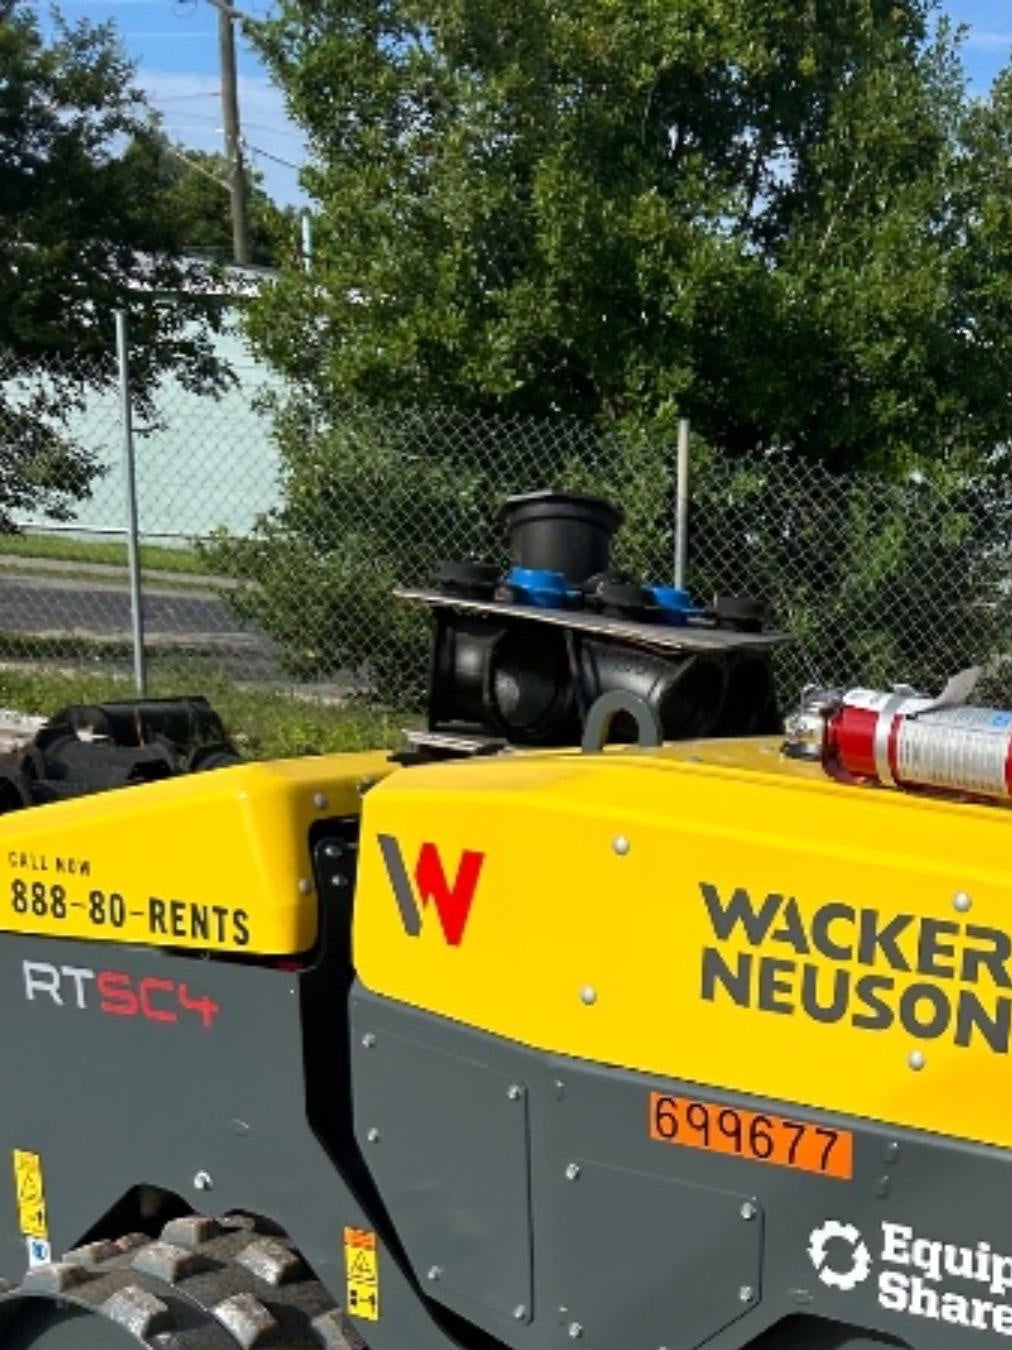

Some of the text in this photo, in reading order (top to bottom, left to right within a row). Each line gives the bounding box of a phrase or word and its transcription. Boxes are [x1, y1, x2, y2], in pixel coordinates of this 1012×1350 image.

[8, 851, 91, 876] CALL NOW
[11, 878, 249, 946] 888-80-RENTS
[22, 960, 220, 1028] RTSC4
[654, 1098, 839, 1172] 699677
